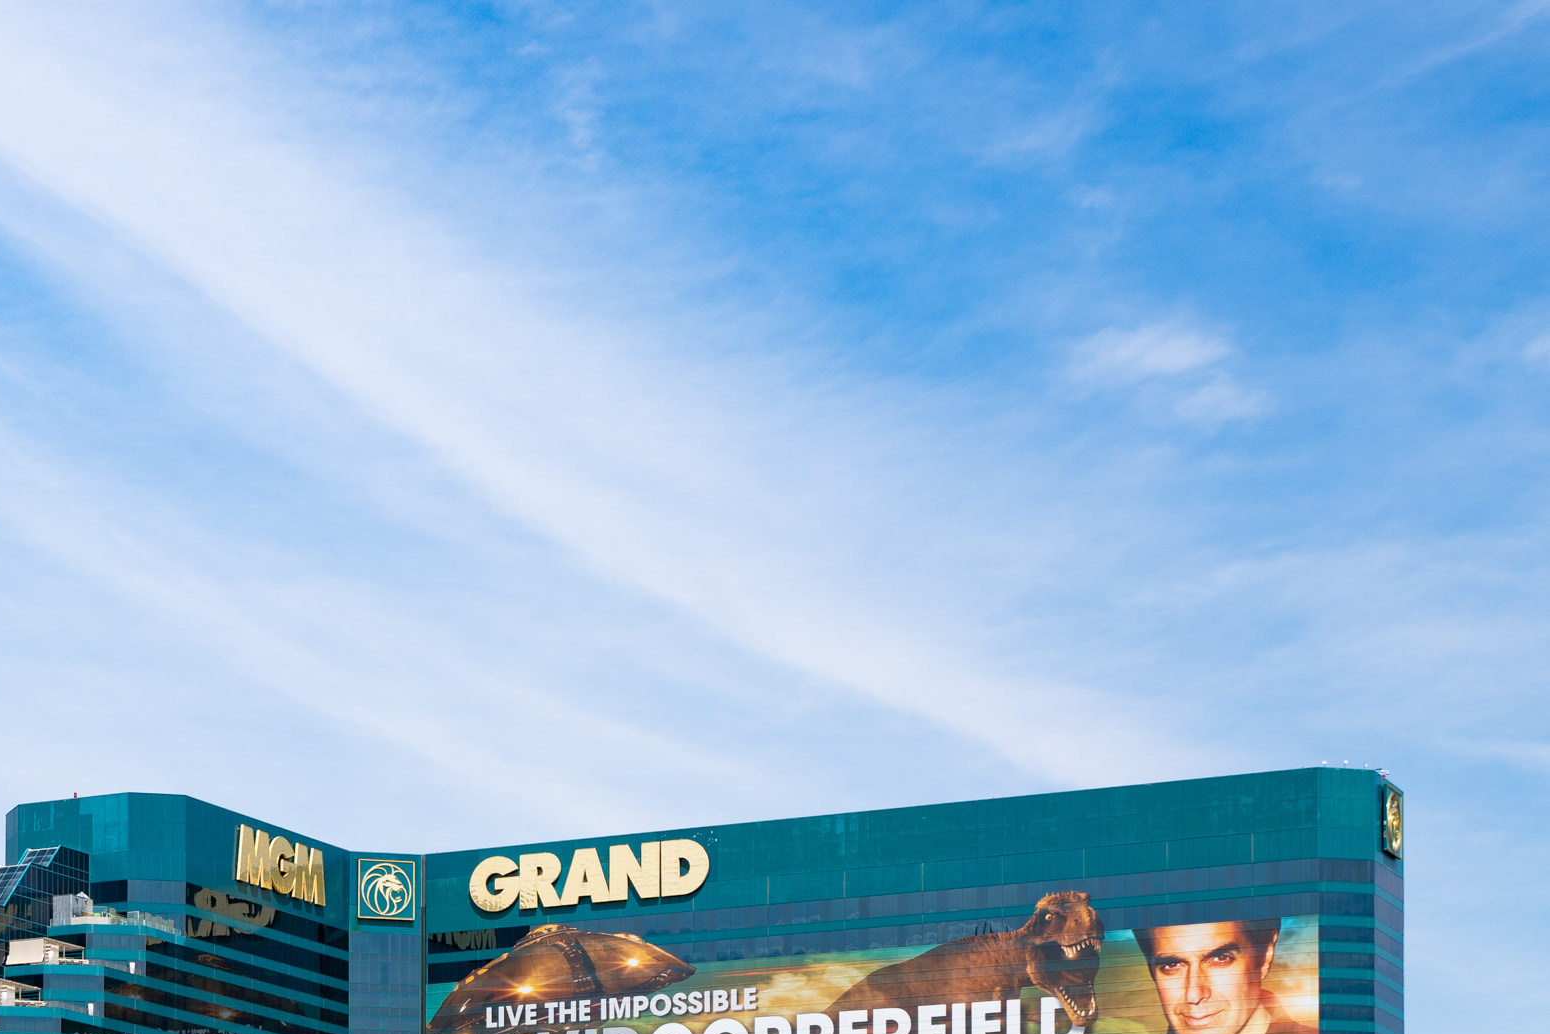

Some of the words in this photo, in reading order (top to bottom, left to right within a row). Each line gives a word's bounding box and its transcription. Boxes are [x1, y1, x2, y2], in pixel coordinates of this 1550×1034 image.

[236, 823, 326, 906] MGM
[469, 838, 710, 913] GRAND
[485, 1003, 537, 1028] LIVE
[545, 1000, 591, 1024] THE
[600, 987, 757, 1020] IMPOSSIBLE
